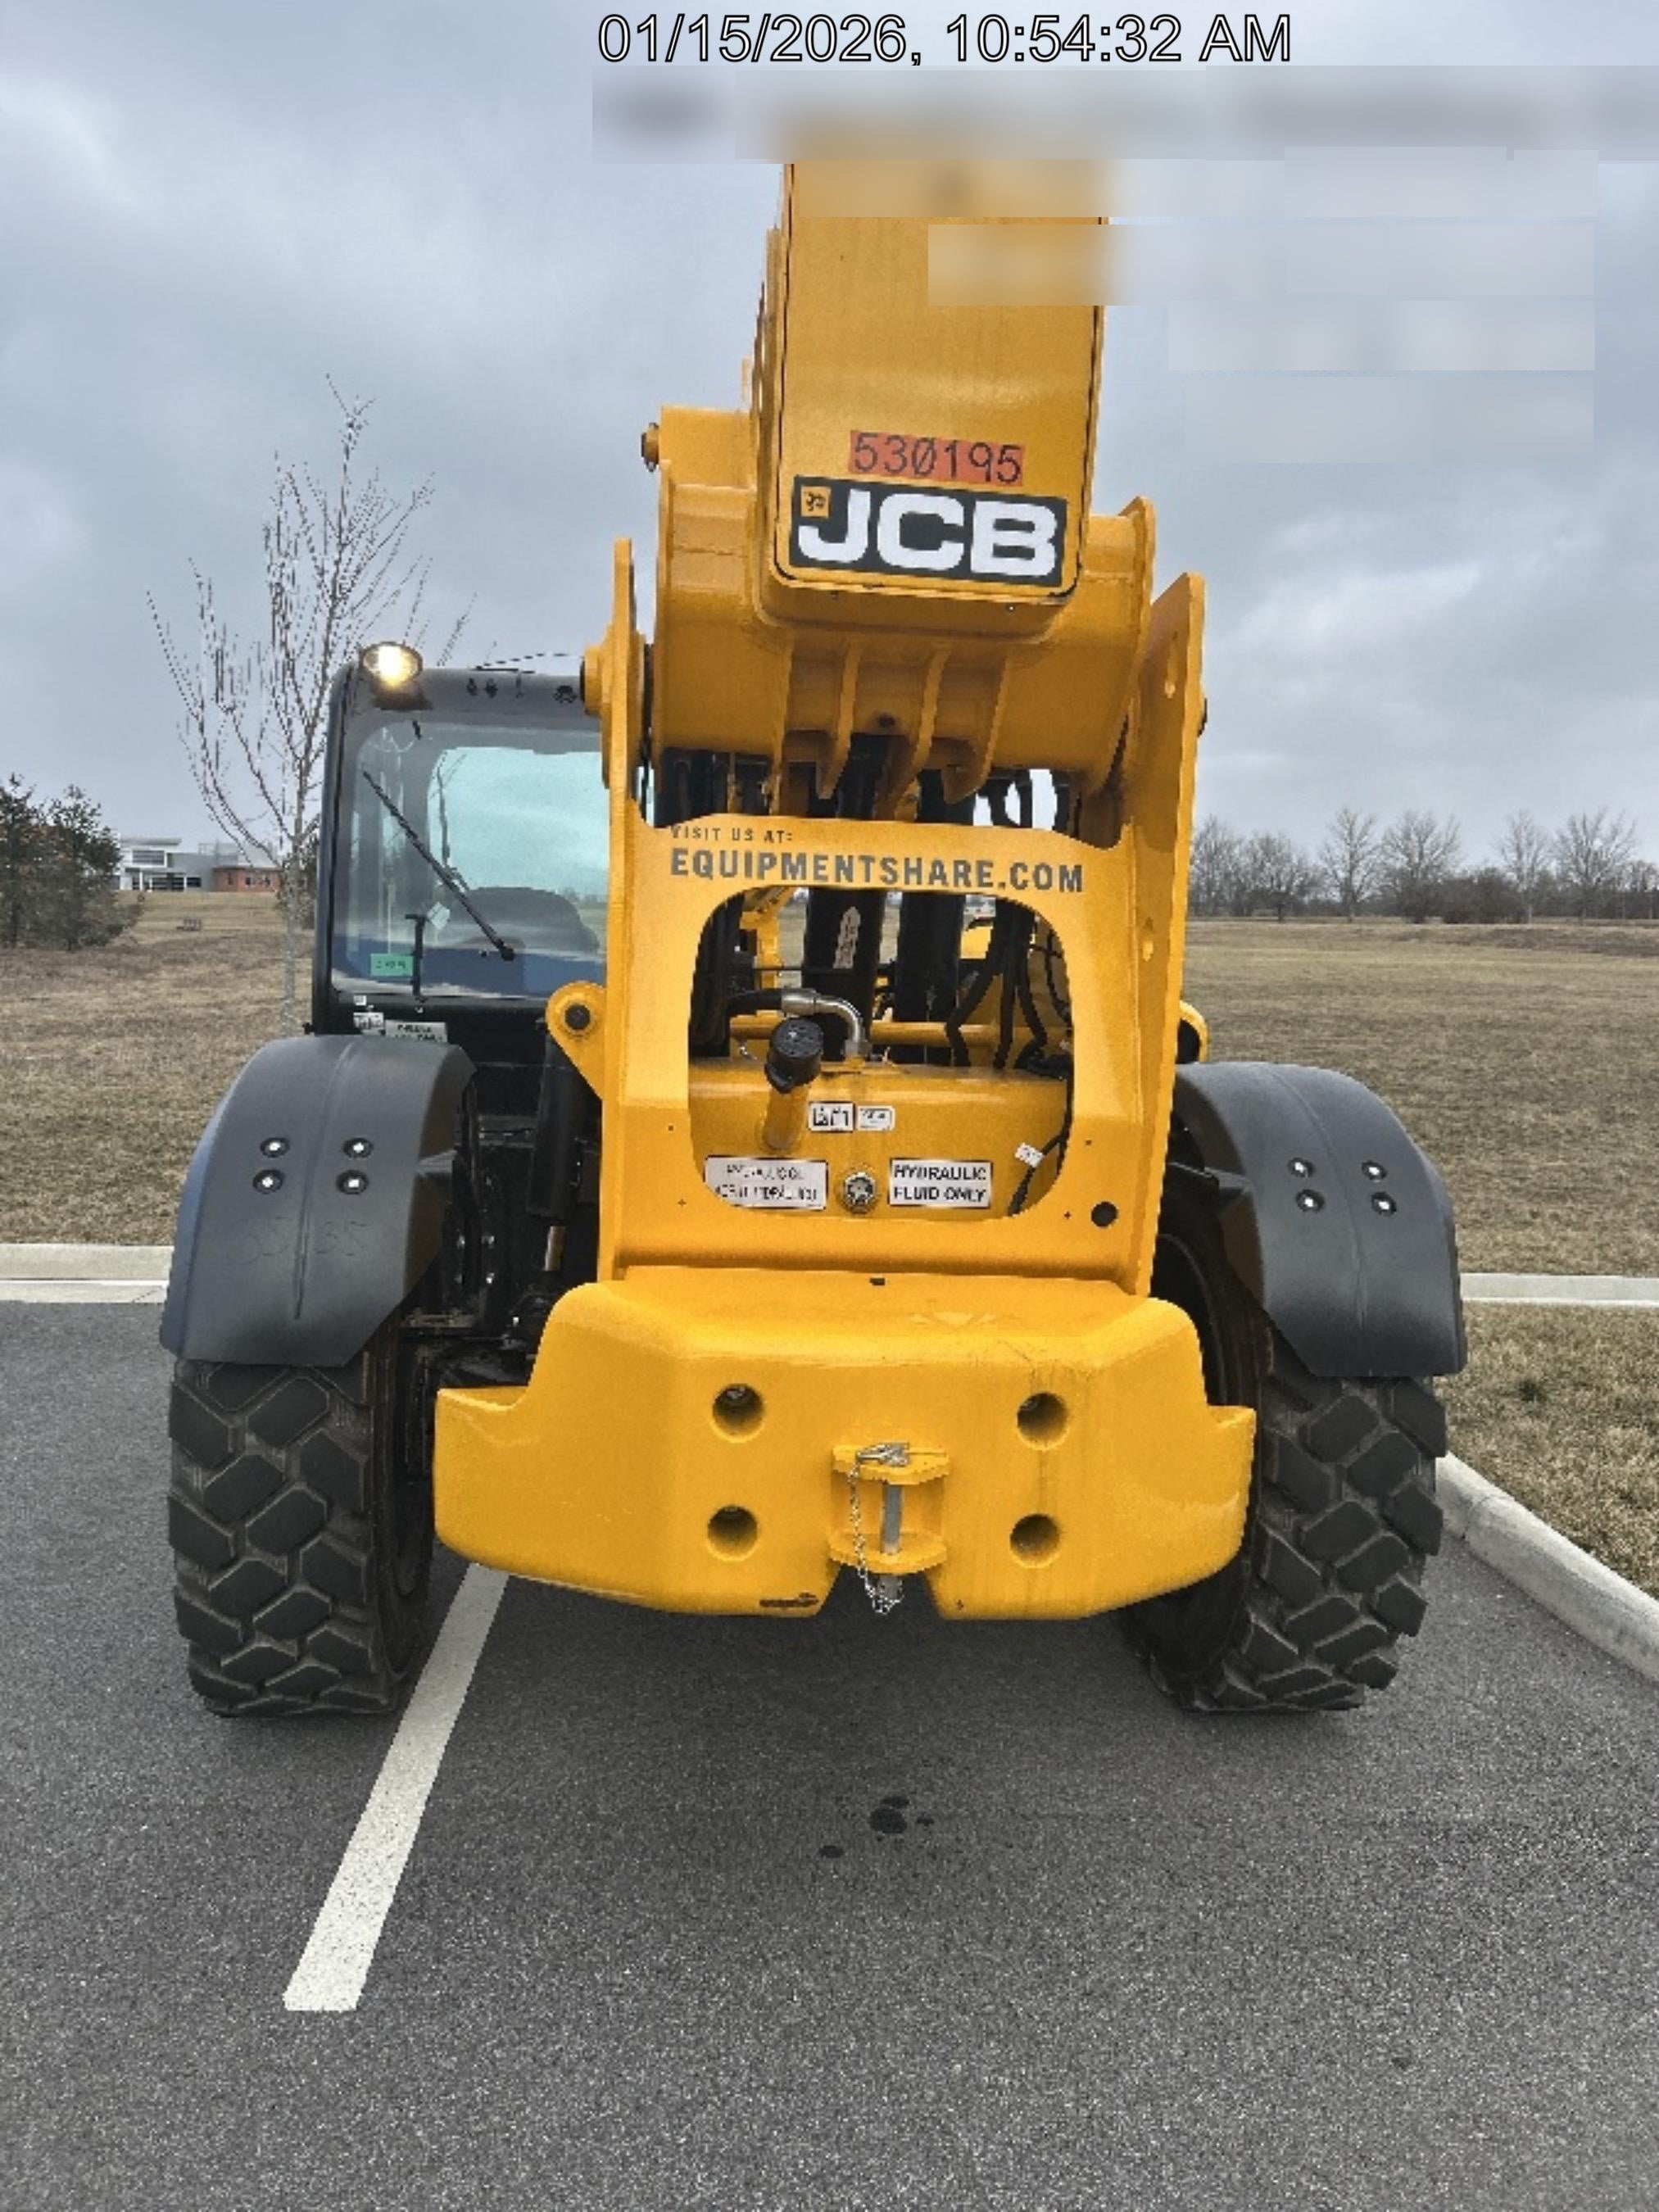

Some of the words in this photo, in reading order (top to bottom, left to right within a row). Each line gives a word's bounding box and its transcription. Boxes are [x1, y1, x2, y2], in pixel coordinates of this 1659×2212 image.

[853, 433, 1022, 483] 530195
[797, 489, 1057, 577] JCB
[671, 825, 721, 841] VISIT
[732, 827, 753, 841] US
[670, 848, 1083, 893] EQUIPMENTSHARE.COM
[894, 1185, 940, 1201] FLUID
[945, 1186, 986, 1203] ONLY
